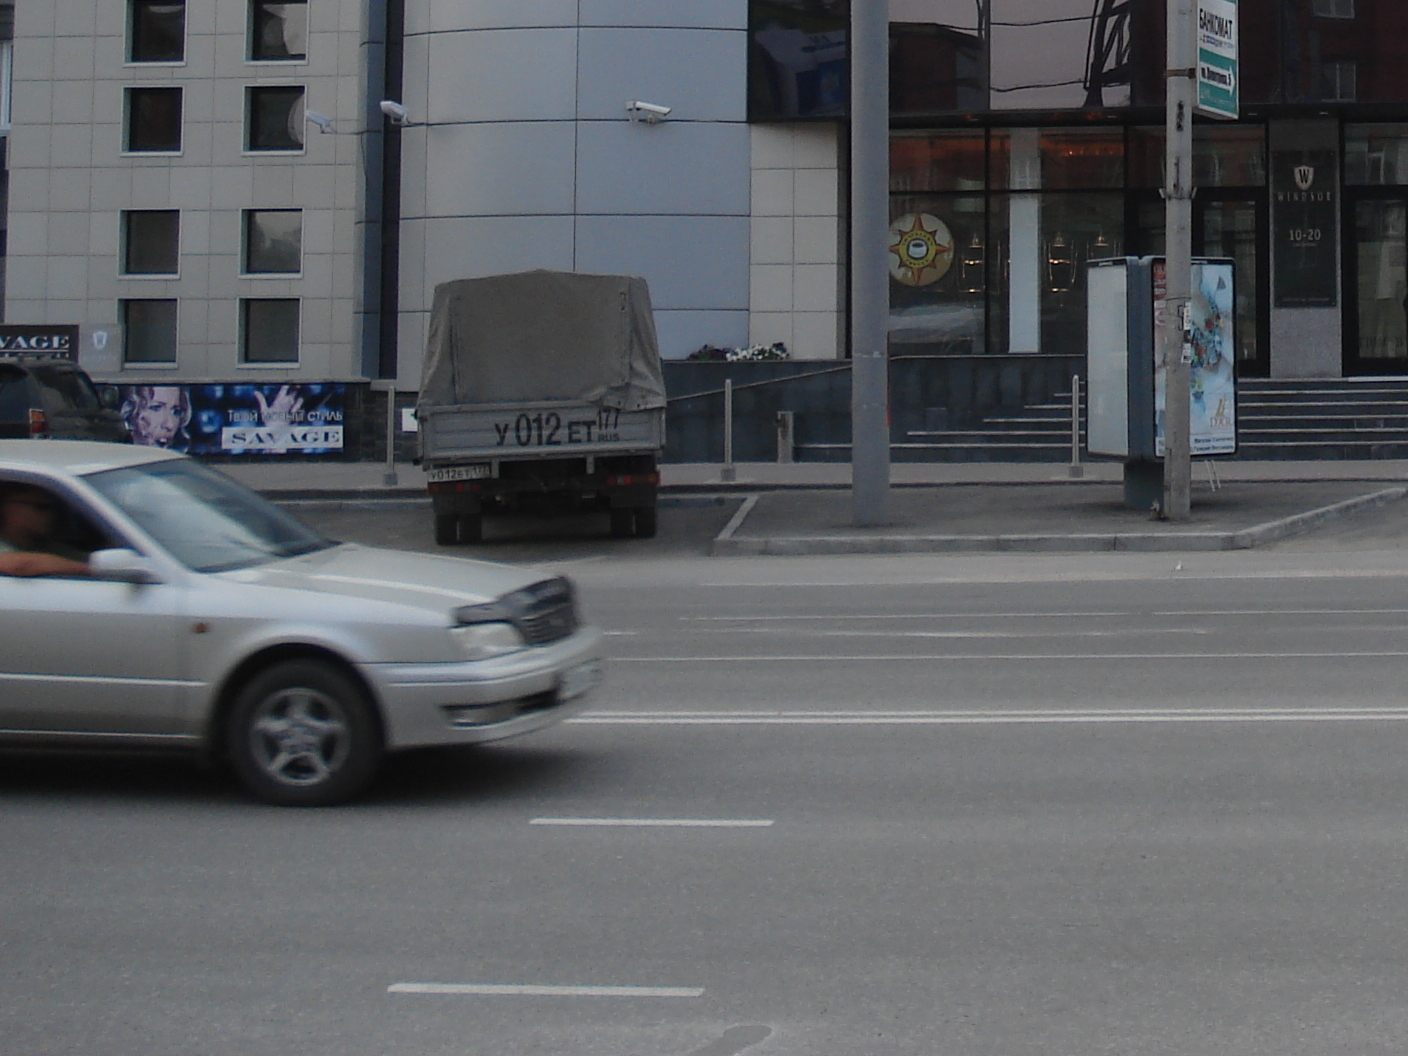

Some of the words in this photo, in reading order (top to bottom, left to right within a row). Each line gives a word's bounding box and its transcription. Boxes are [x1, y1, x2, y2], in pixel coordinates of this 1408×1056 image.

[1200, 8, 1233, 40] БАНКОМАТ
[1278, 192, 1332, 201] WINDSOR
[1289, 229, 1321, 241] 10-20
[515, 412, 561, 446] 012
[567, 420, 596, 443] ЕТ
[232, 431, 340, 444] SAVAGE
